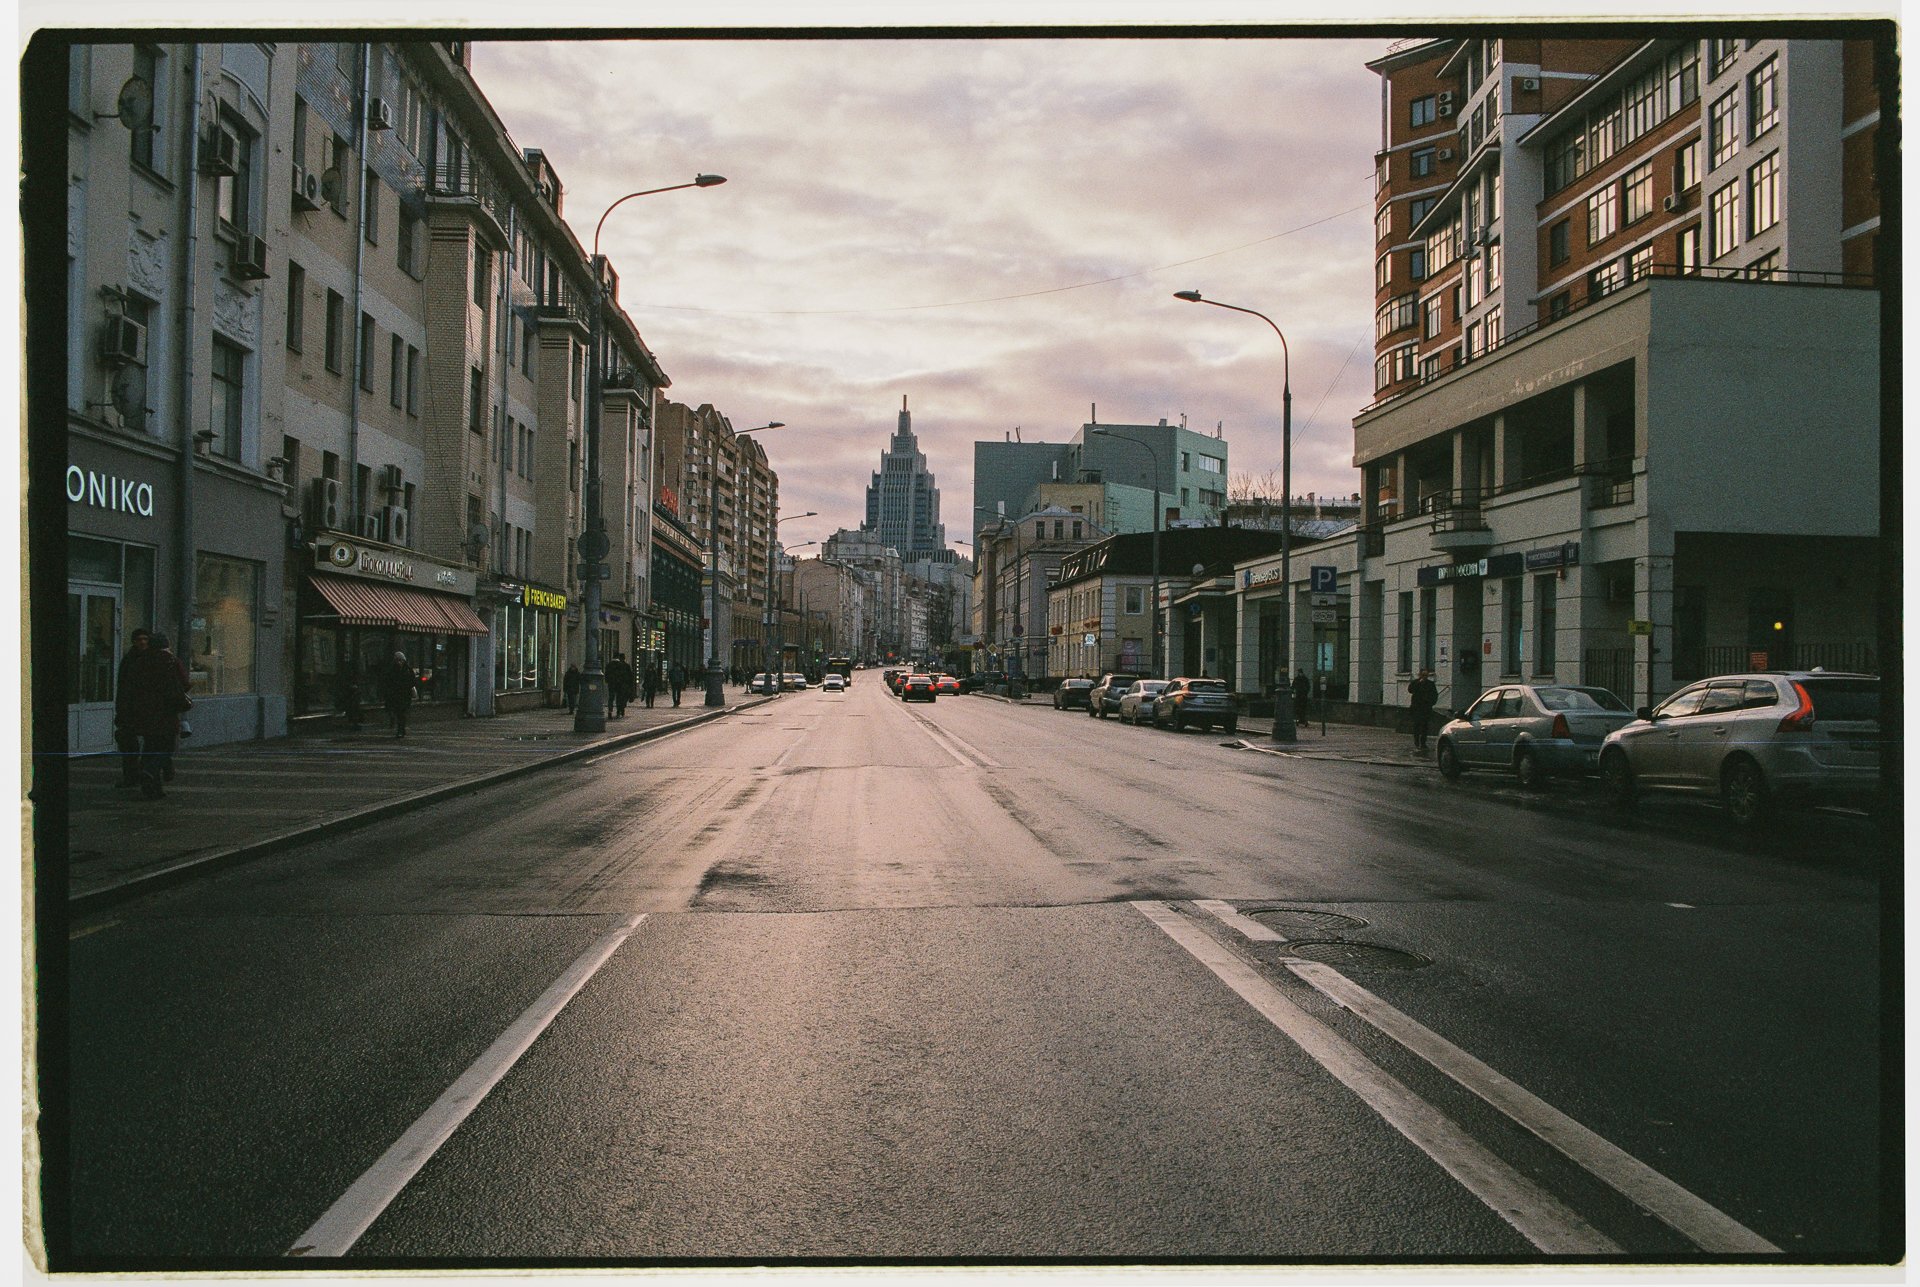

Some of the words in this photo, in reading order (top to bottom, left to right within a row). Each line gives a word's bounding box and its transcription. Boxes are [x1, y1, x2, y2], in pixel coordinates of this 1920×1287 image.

[1317, 569, 1332, 590] P
[531, 589, 549, 607] FRENCH
[550, 593, 566, 609] BAKERY
